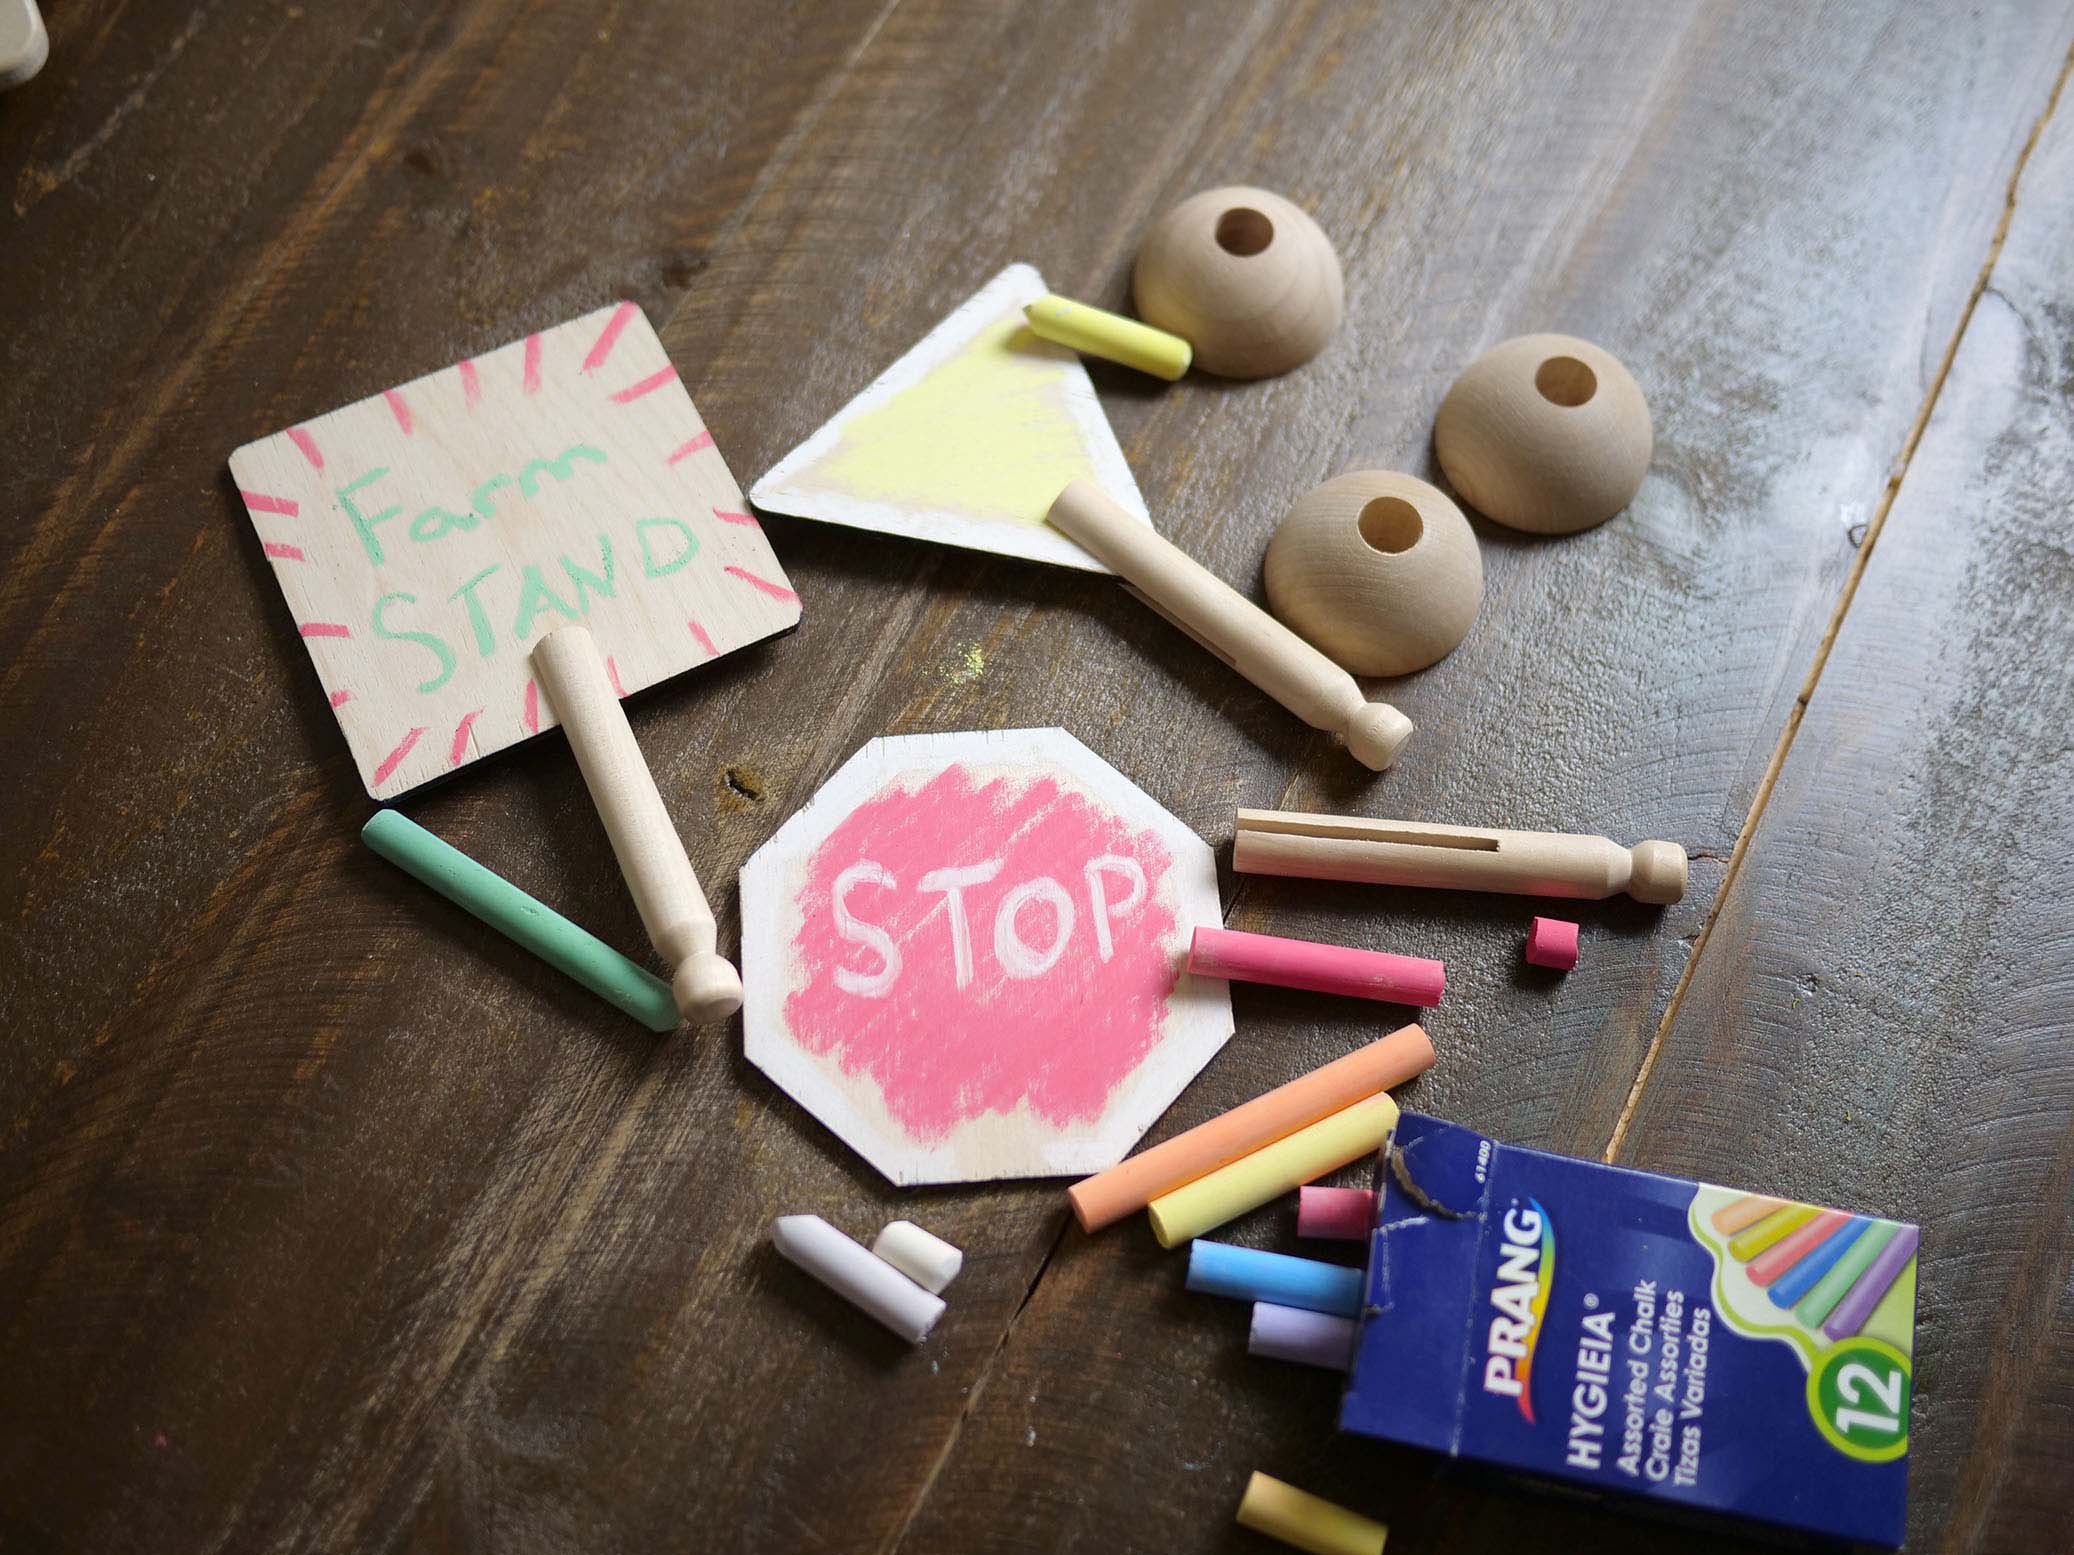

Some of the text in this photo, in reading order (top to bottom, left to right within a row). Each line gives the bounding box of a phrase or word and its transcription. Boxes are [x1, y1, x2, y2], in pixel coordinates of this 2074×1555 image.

[336, 444, 608, 567] Farm
[371, 516, 701, 694] STAND
[831, 853, 1149, 999] STOP
[1484, 1207, 1544, 1397] PRANG
[1565, 1311, 1616, 1471] HYGIEIA
[1616, 1279, 1658, 1478] Assorted Chalk
[1644, 1288, 1686, 1482] Craie Assorties
[1673, 1306, 1712, 1487] Tizas Variadas
[1835, 1363, 1902, 1434] 12
